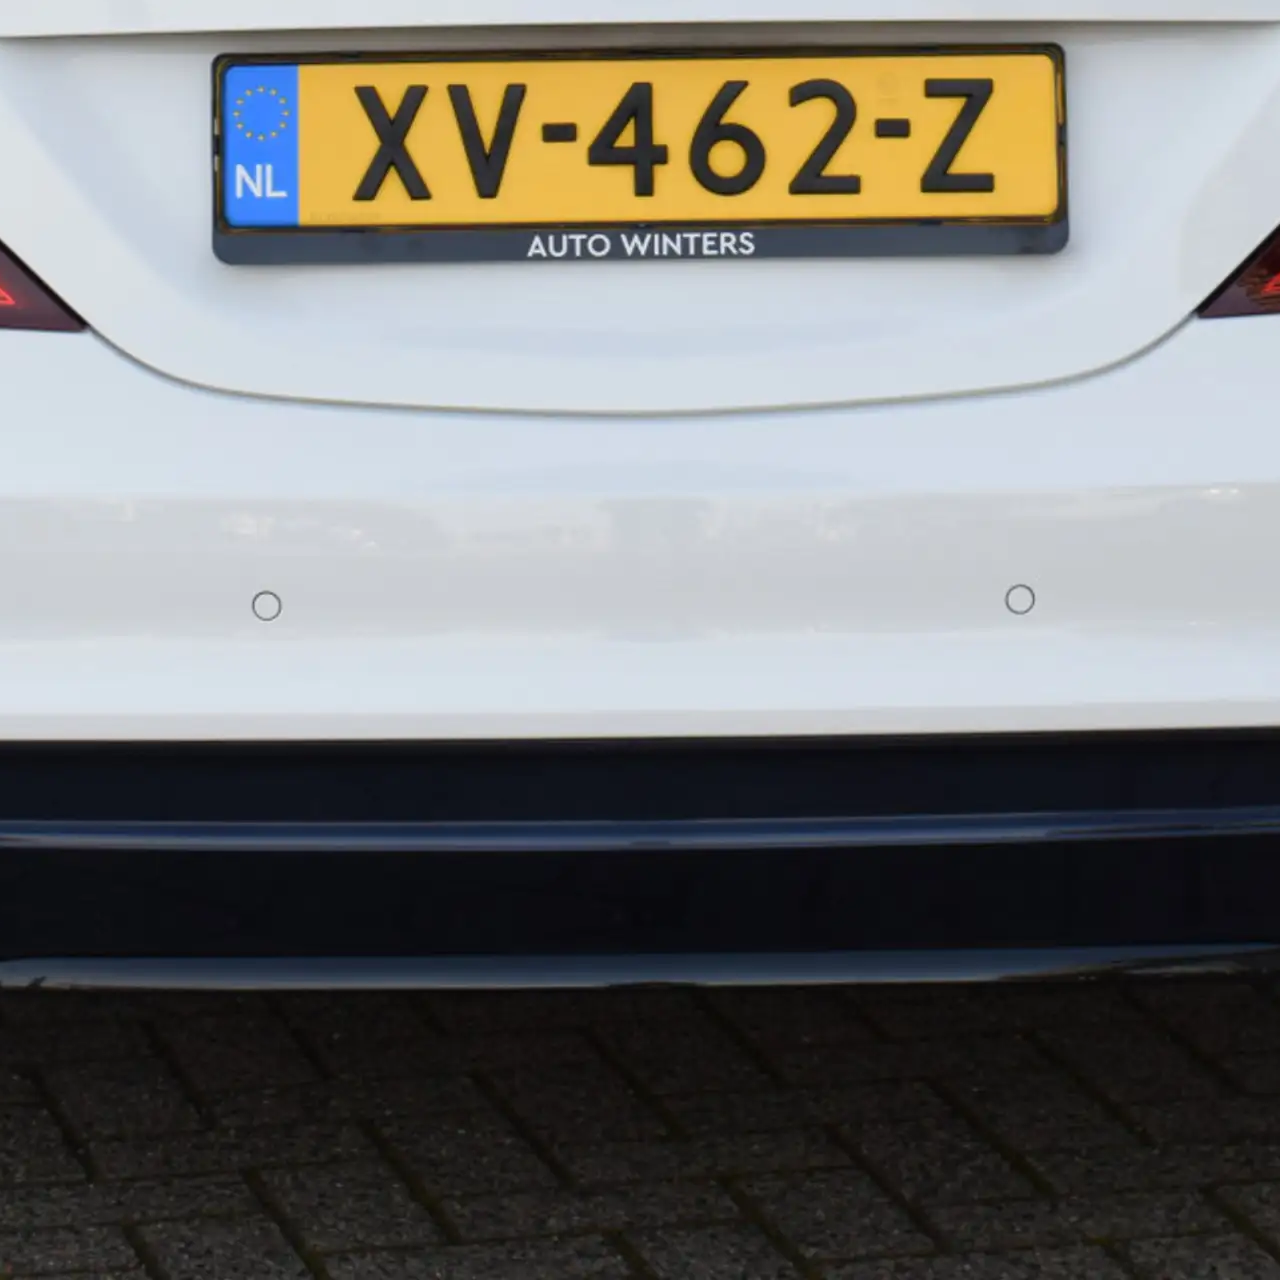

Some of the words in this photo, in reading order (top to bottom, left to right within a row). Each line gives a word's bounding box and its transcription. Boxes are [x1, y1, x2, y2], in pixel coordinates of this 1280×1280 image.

[352, 78, 995, 201] XV-462-Z
[234, 164, 288, 199] NL
[526, 232, 612, 258] AUTO
[619, 231, 756, 257] WINTERS
